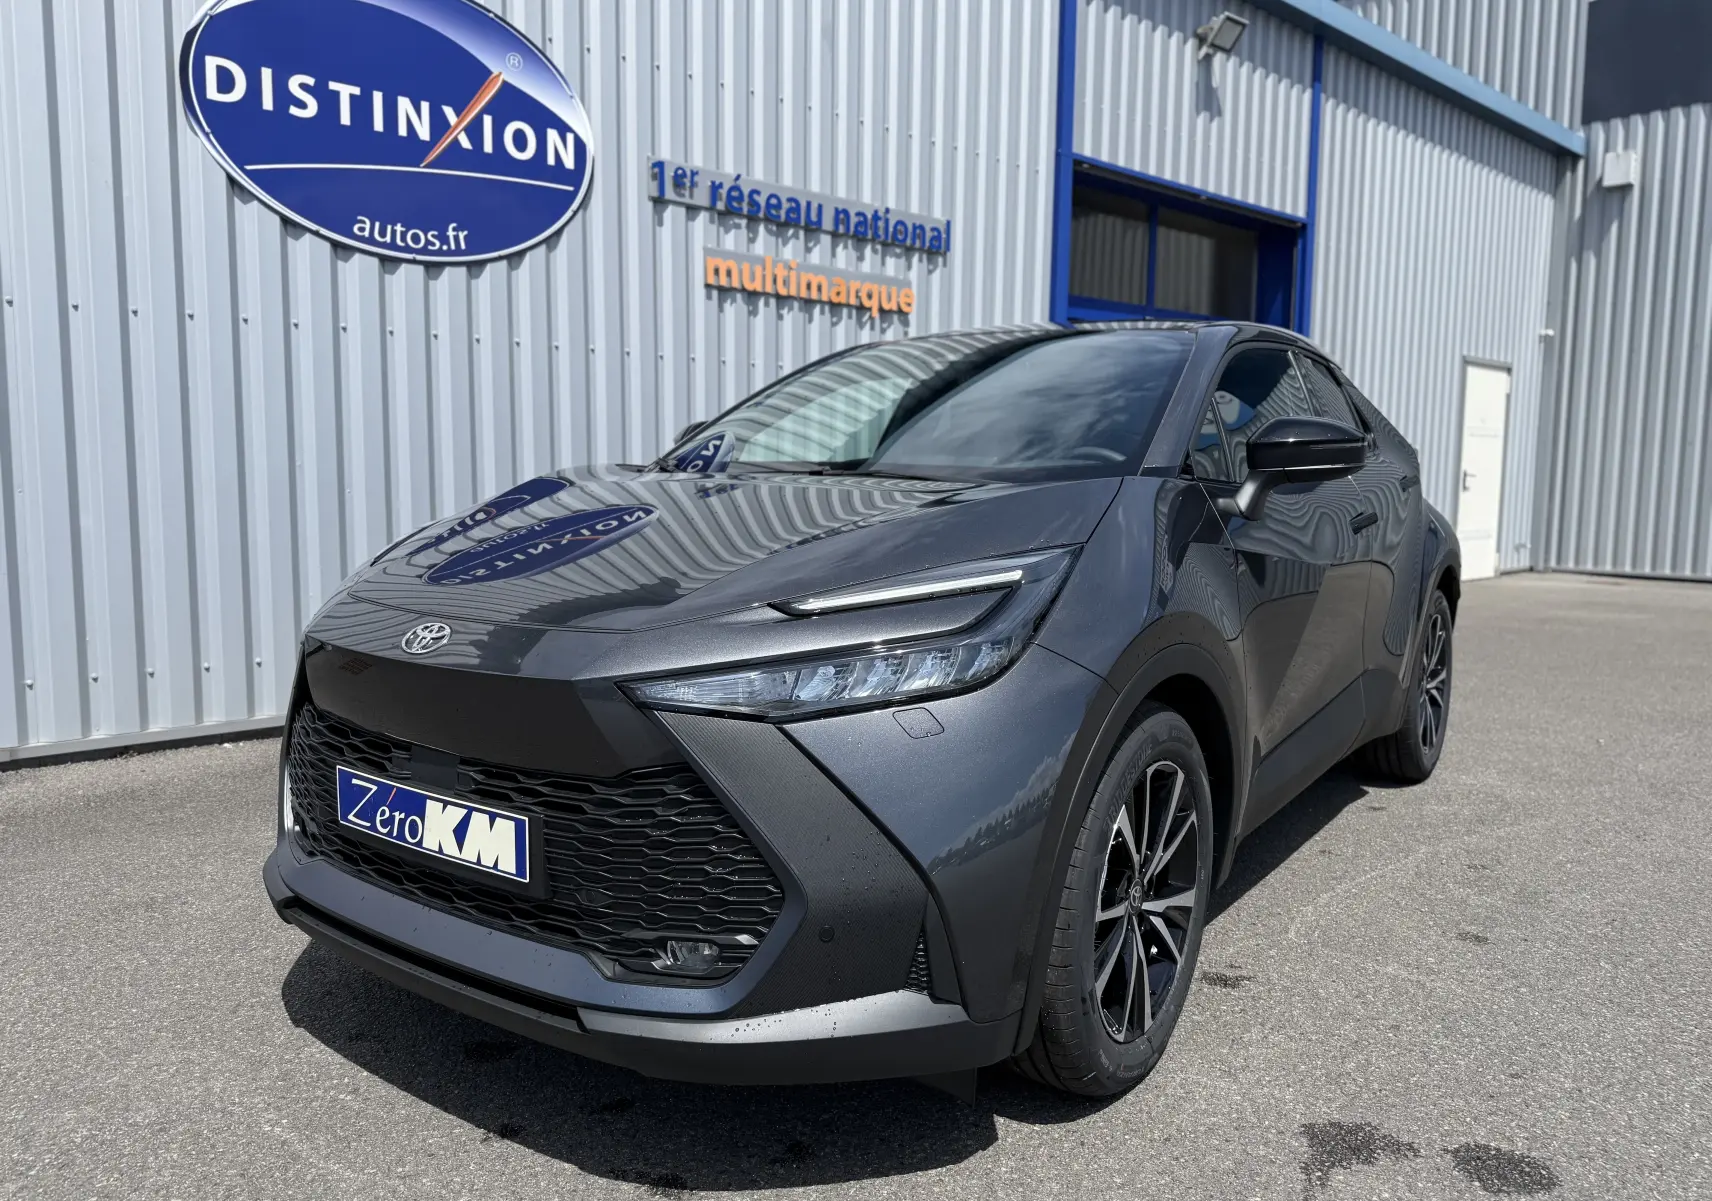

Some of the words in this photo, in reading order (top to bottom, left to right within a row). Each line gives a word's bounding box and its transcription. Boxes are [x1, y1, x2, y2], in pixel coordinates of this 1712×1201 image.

[204, 55, 576, 170] DISTINXION
[353, 215, 469, 251] autos.fr
[651, 160, 699, 198] 1er
[709, 174, 824, 229] réseau
[834, 207, 952, 253] national
[705, 255, 916, 318] multimarque
